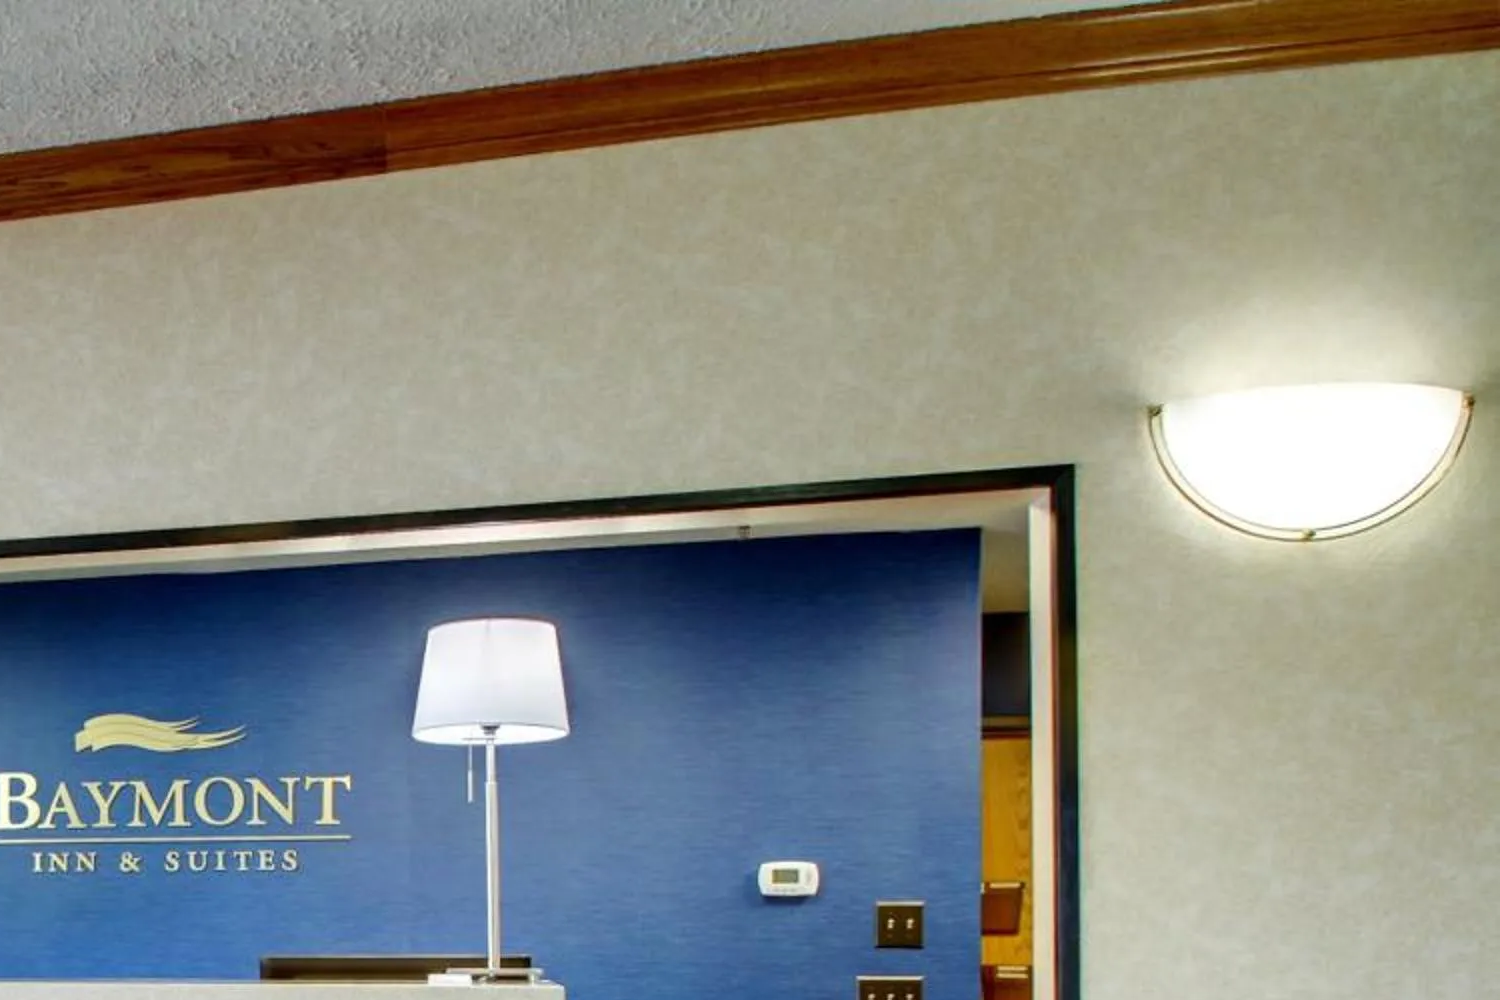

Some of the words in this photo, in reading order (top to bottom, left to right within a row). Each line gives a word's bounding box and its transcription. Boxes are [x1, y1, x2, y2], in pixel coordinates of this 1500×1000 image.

[31, 851, 97, 873] INN
[118, 851, 142, 872] &
[164, 849, 299, 873] SUITES
